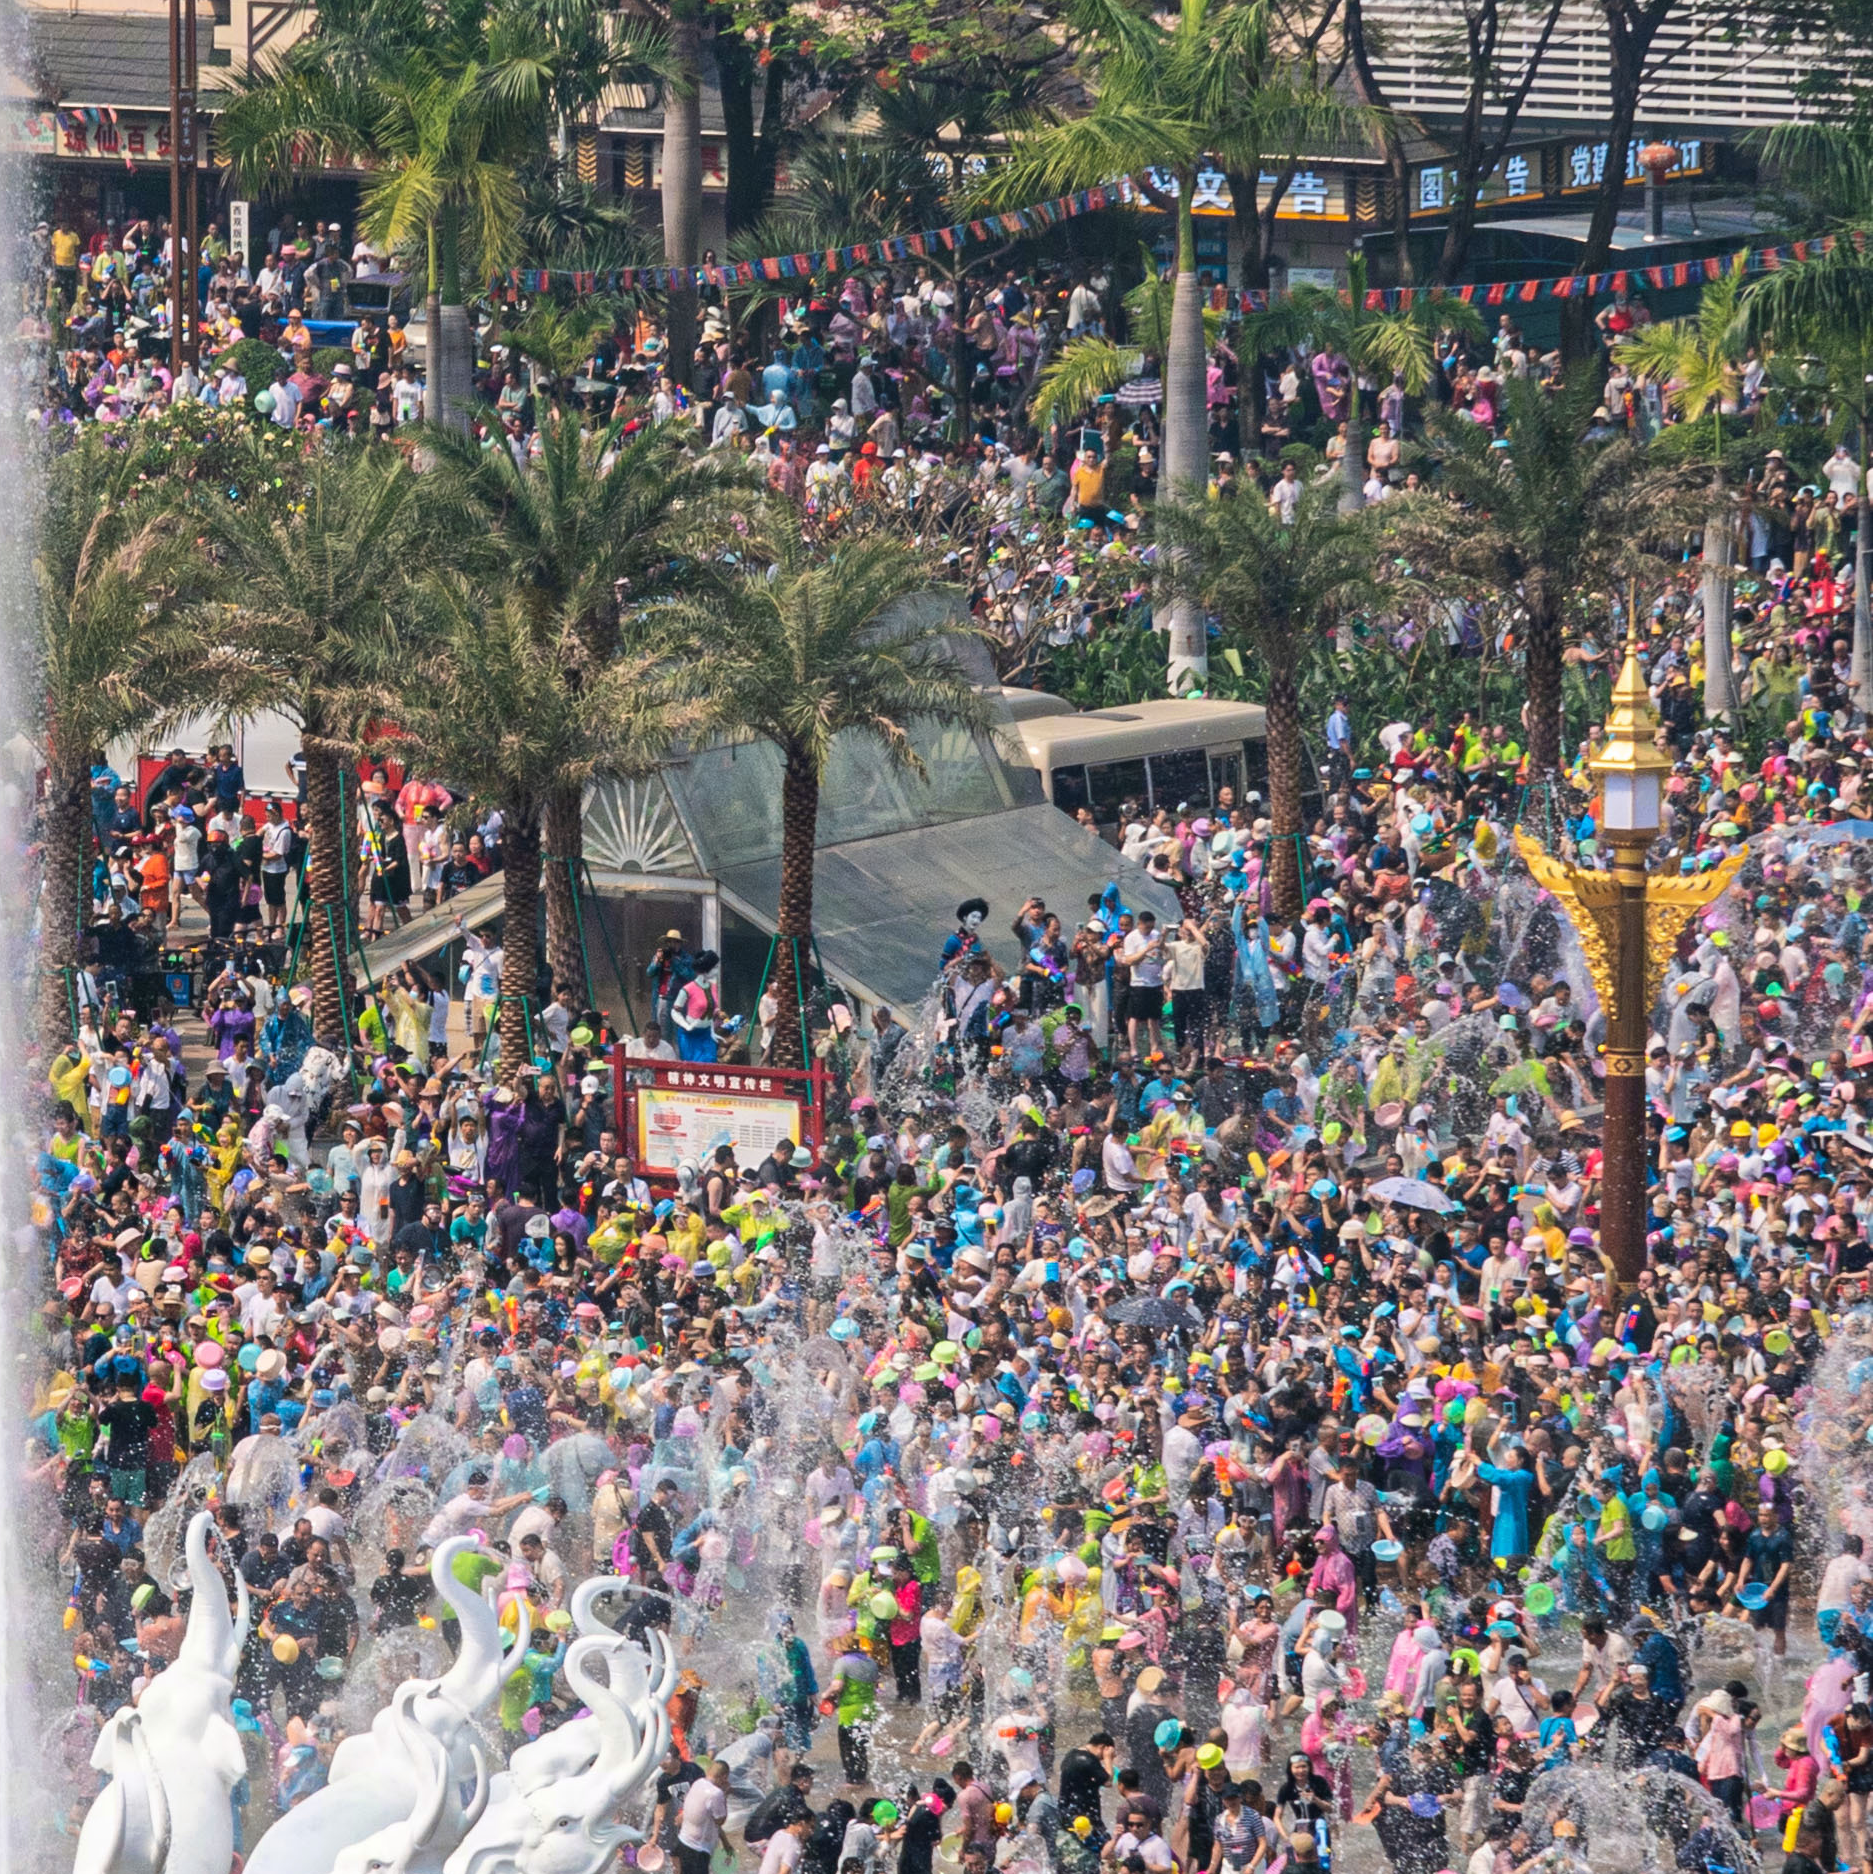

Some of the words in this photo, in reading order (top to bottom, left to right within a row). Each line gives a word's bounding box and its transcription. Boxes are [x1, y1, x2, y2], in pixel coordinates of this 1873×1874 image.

[667, 1070, 772, 1093] 精神文明宣传栏
